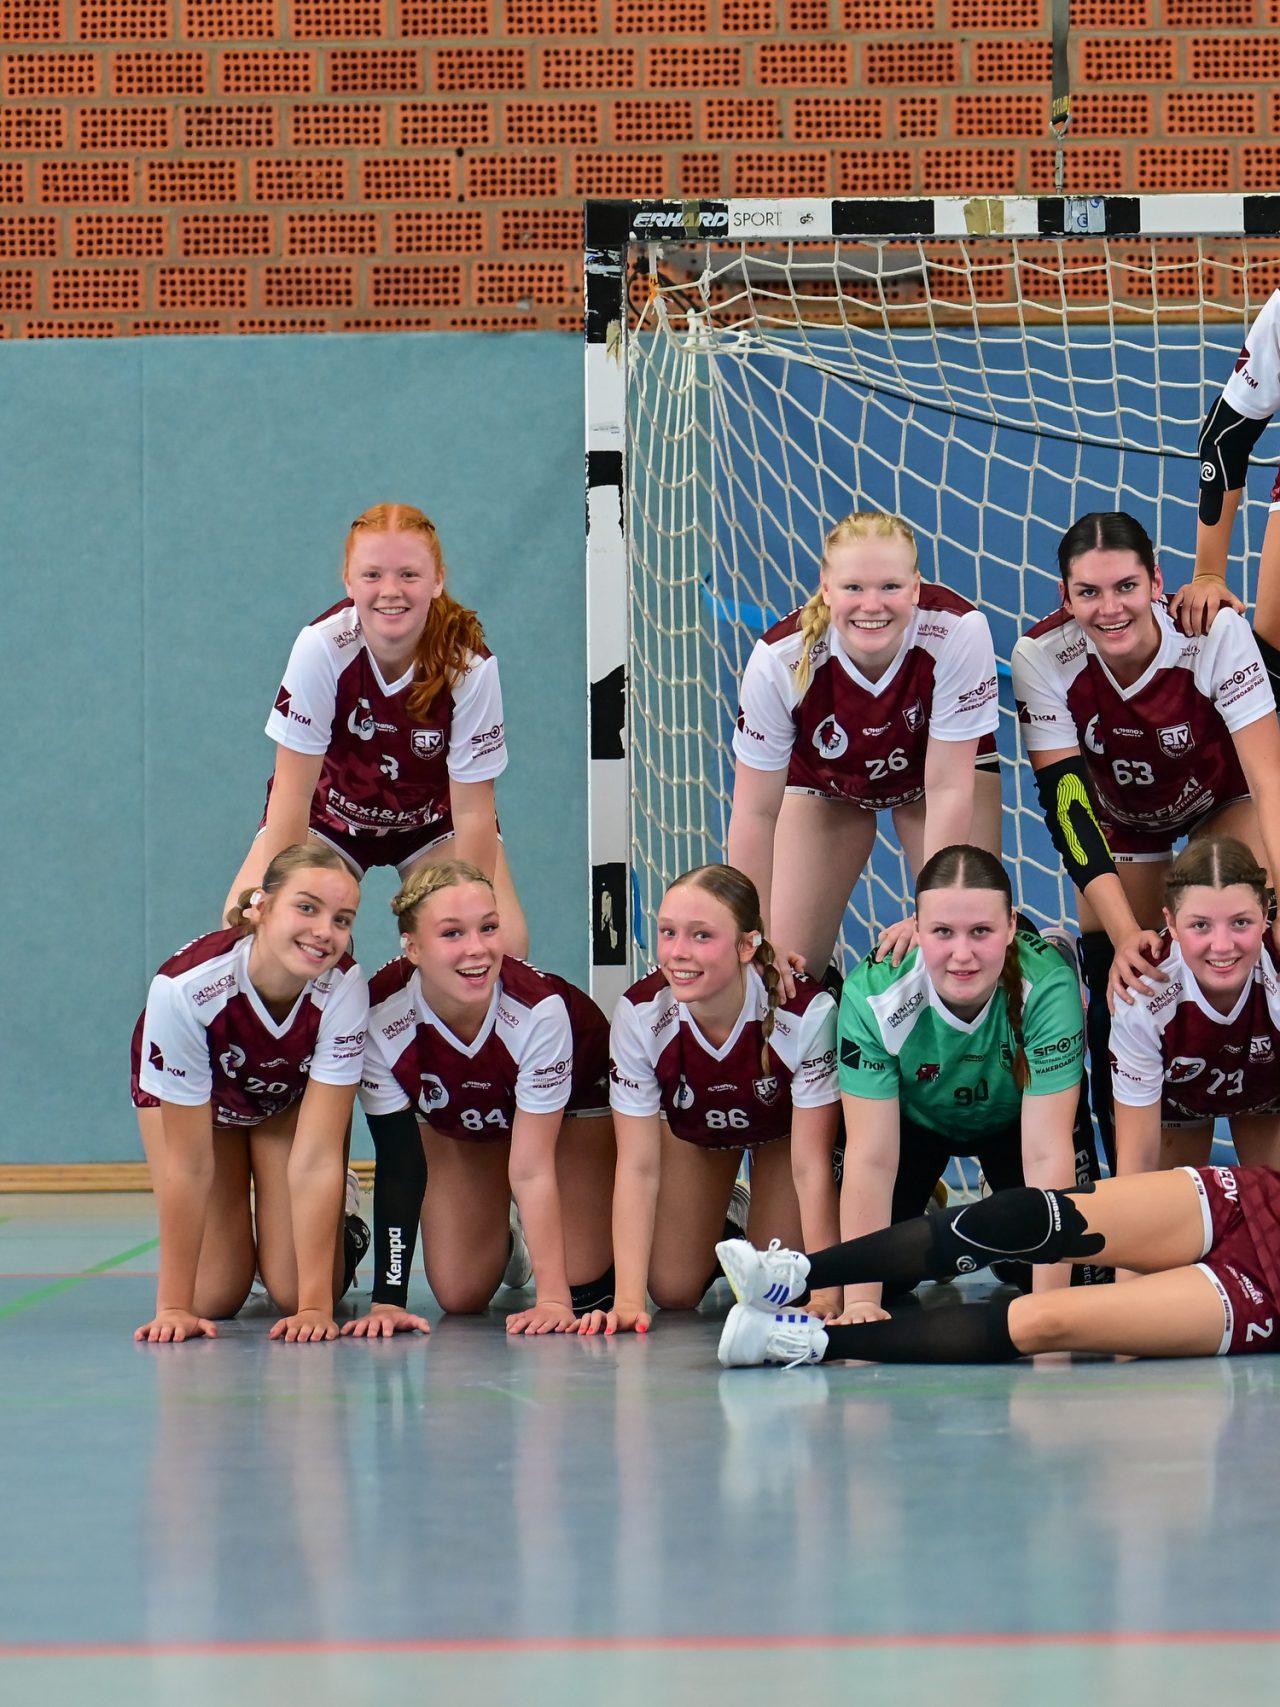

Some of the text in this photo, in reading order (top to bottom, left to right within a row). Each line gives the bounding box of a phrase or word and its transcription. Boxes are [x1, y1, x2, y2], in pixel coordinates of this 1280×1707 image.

[633, 212, 782, 228] ERHARD SPORT
[1241, 368, 1259, 390] TKM
[1056, 643, 1077, 661] RALPH
[1219, 661, 1260, 692] SPOTZ
[958, 676, 997, 703] SPOTZ
[1221, 684, 1254, 708] WAKEBOARD
[289, 709, 312, 727] TKM
[743, 726, 765, 742] TKM
[379, 753, 400, 781] 3
[865, 747, 909, 781] 26
[1111, 758, 1155, 786] 63
[192, 983, 215, 1001] RALPH
[887, 1004, 906, 1025] RALPH
[382, 1017, 403, 1037] RALPH
[862, 1059, 887, 1071] TKM
[1035, 1055, 1076, 1074] WAKEBOARD
[244, 1077, 289, 1094] 20
[460, 1108, 510, 1131] 84
[705, 1108, 750, 1129] 86
[386, 1227, 406, 1286] Kempa
[1246, 1318, 1274, 1343] 2
